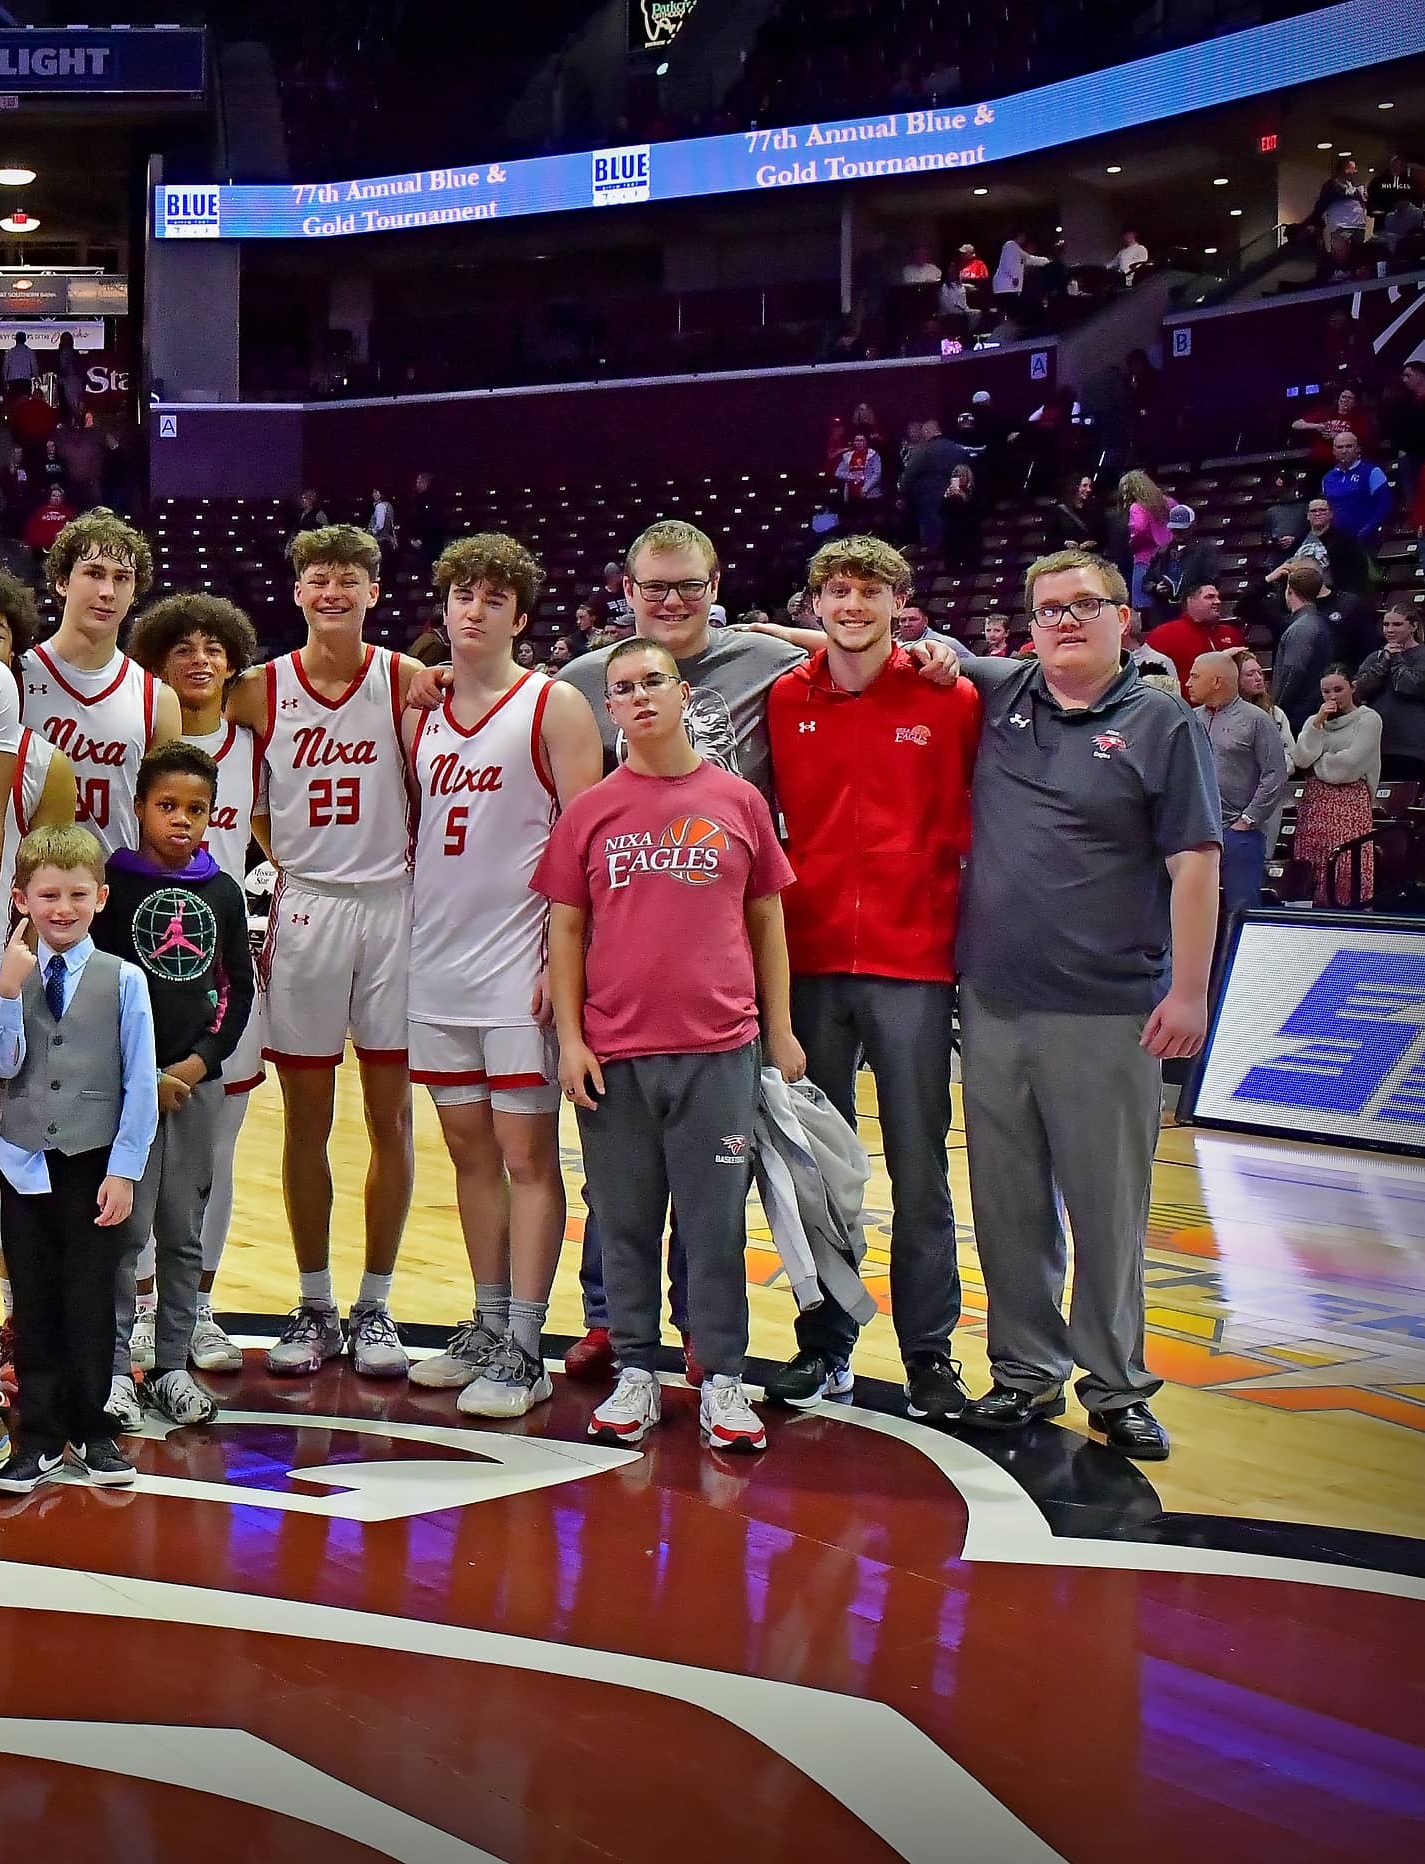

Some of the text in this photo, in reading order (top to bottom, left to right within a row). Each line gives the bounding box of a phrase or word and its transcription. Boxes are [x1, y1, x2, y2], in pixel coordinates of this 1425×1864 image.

[745, 104, 996, 155] 77th Annual Blue &
[1261, 135, 1278, 152] EXIT
[292, 163, 508, 205] 77th Annual Blue &
[595, 153, 647, 182] BLUE
[755, 144, 986, 188] Gold Tournament
[167, 194, 218, 216] BLUE
[303, 199, 498, 236] Gold Tournament
[1176, 333, 1188, 352] B
[1032, 357, 1046, 376] A
[162, 419, 176, 433] A
[42, 716, 128, 767] Nixa
[292, 726, 378, 770] Nixa
[429, 753, 504, 797] Nixa
[308, 776, 361, 828] 23
[443, 806, 470, 856] 5
[604, 831, 654, 853] NIXA
[606, 847, 719, 889] EAGLES
